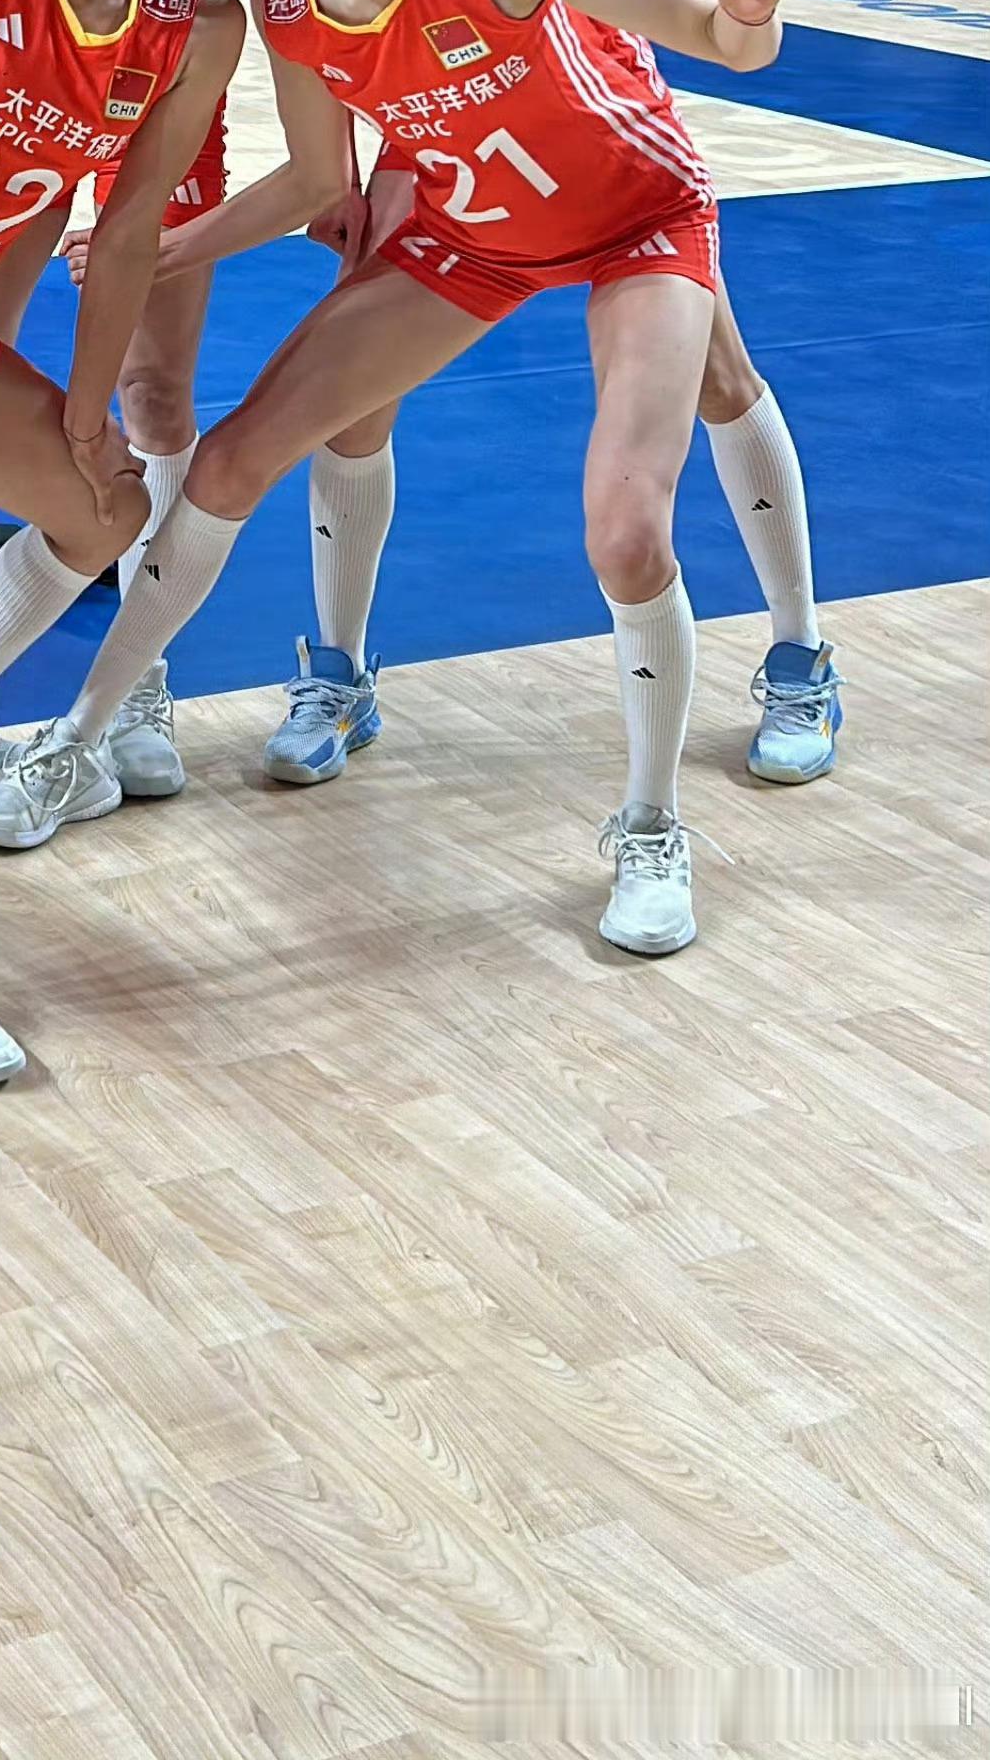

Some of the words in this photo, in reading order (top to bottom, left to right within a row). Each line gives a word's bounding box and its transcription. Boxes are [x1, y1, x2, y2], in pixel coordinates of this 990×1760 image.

[447, 44, 483, 65] CHN
[375, 54, 531, 124] 太平洋保险
[108, 102, 140, 117] CHN
[396, 119, 453, 140] CPIC
[415, 127, 560, 223] 21
